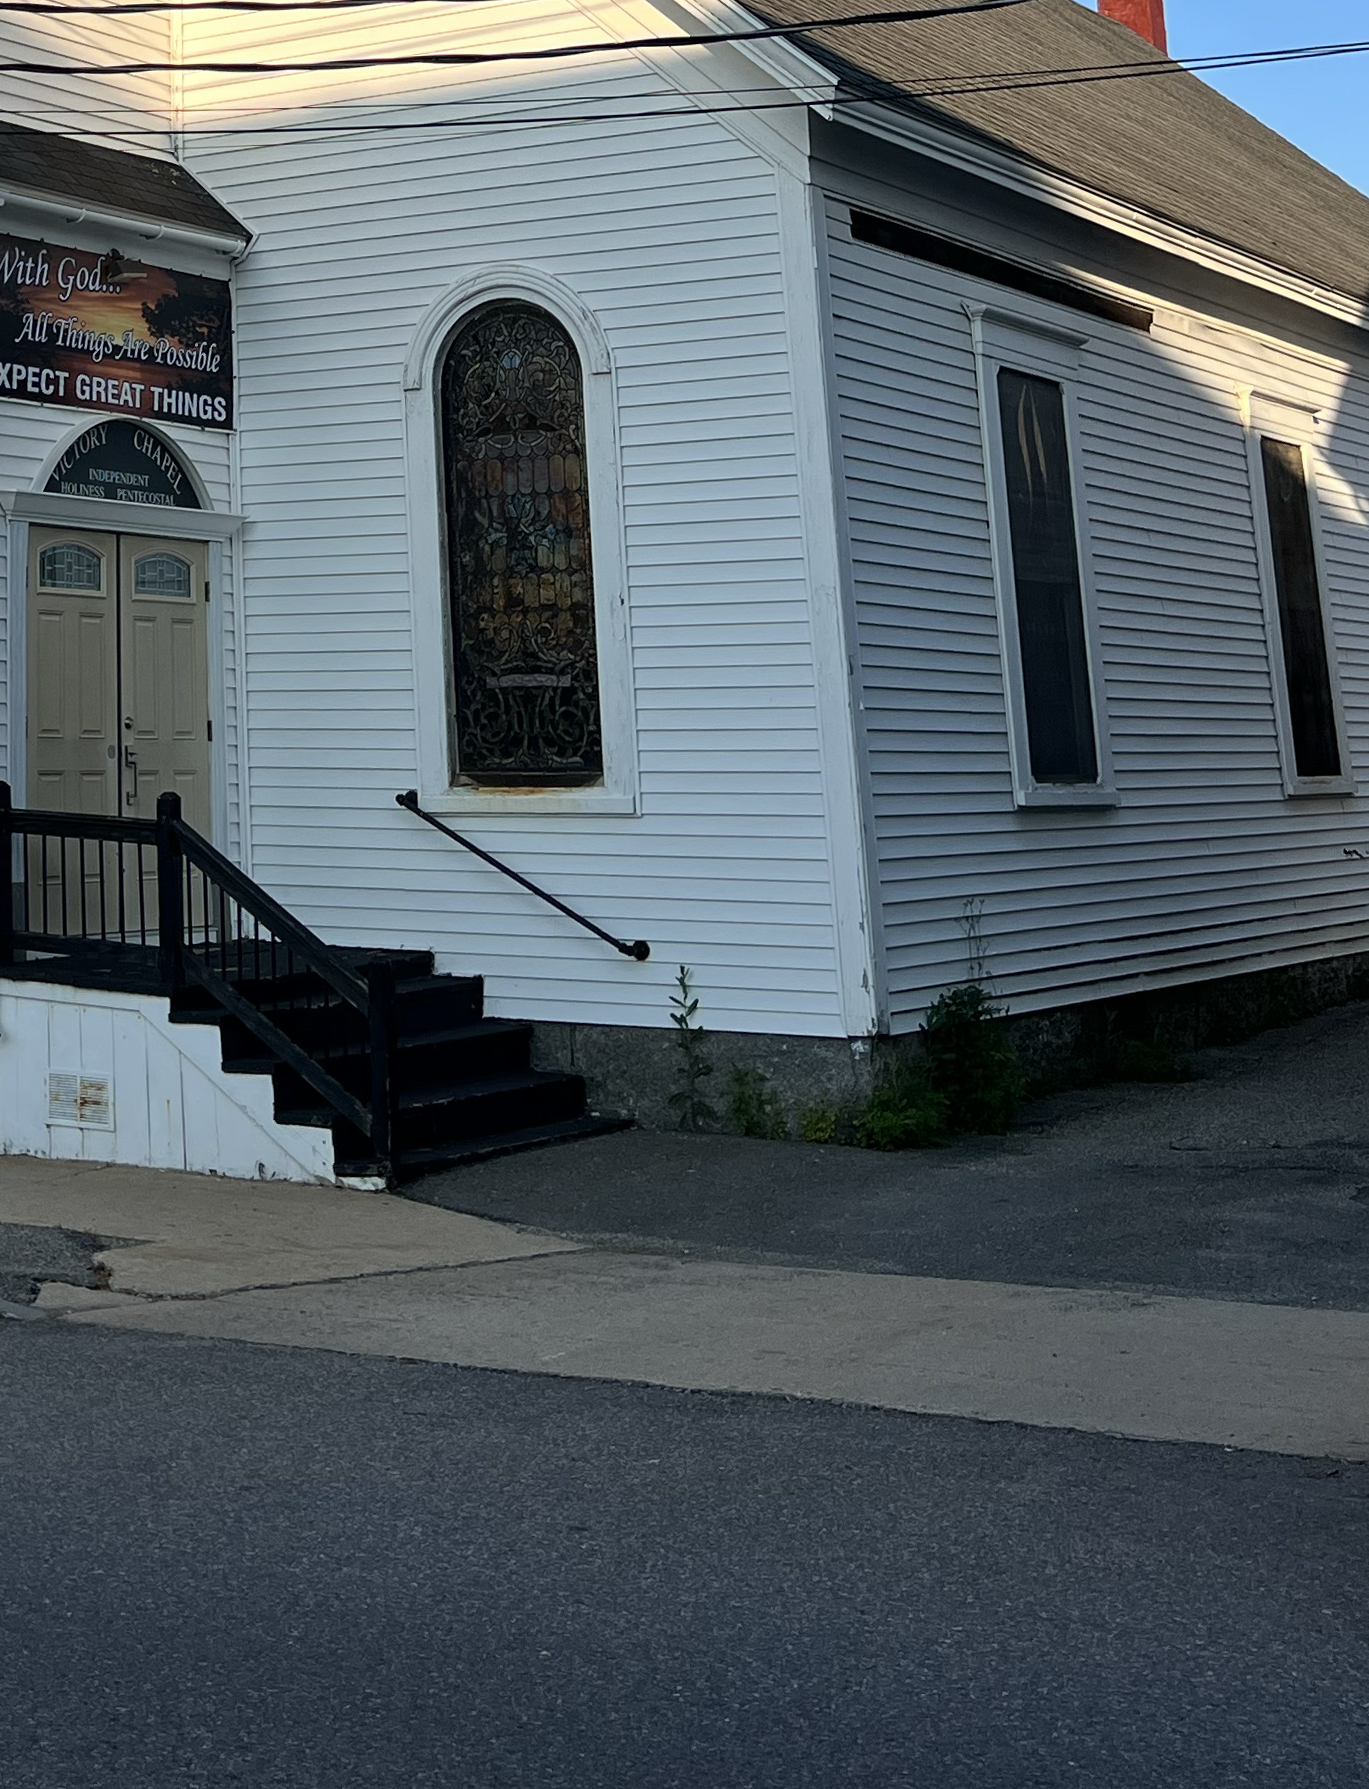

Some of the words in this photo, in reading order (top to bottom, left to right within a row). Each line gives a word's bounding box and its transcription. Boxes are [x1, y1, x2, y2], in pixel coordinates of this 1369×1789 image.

[57, 256, 121, 301] God...
[15, 312, 52, 343] All
[52, 316, 113, 362] Things
[115, 329, 149, 361] Are
[154, 337, 220, 373] Possible
[76, 374, 144, 409] GREAT
[150, 386, 227, 421] THINGS
[52, 423, 109, 481] VICTORY
[133, 429, 183, 495] CHAPEL
[89, 468, 150, 487] INDEPENDENT
[61, 481, 105, 498] HOLINESS
[117, 488, 176, 506] PENTECOSTAL
